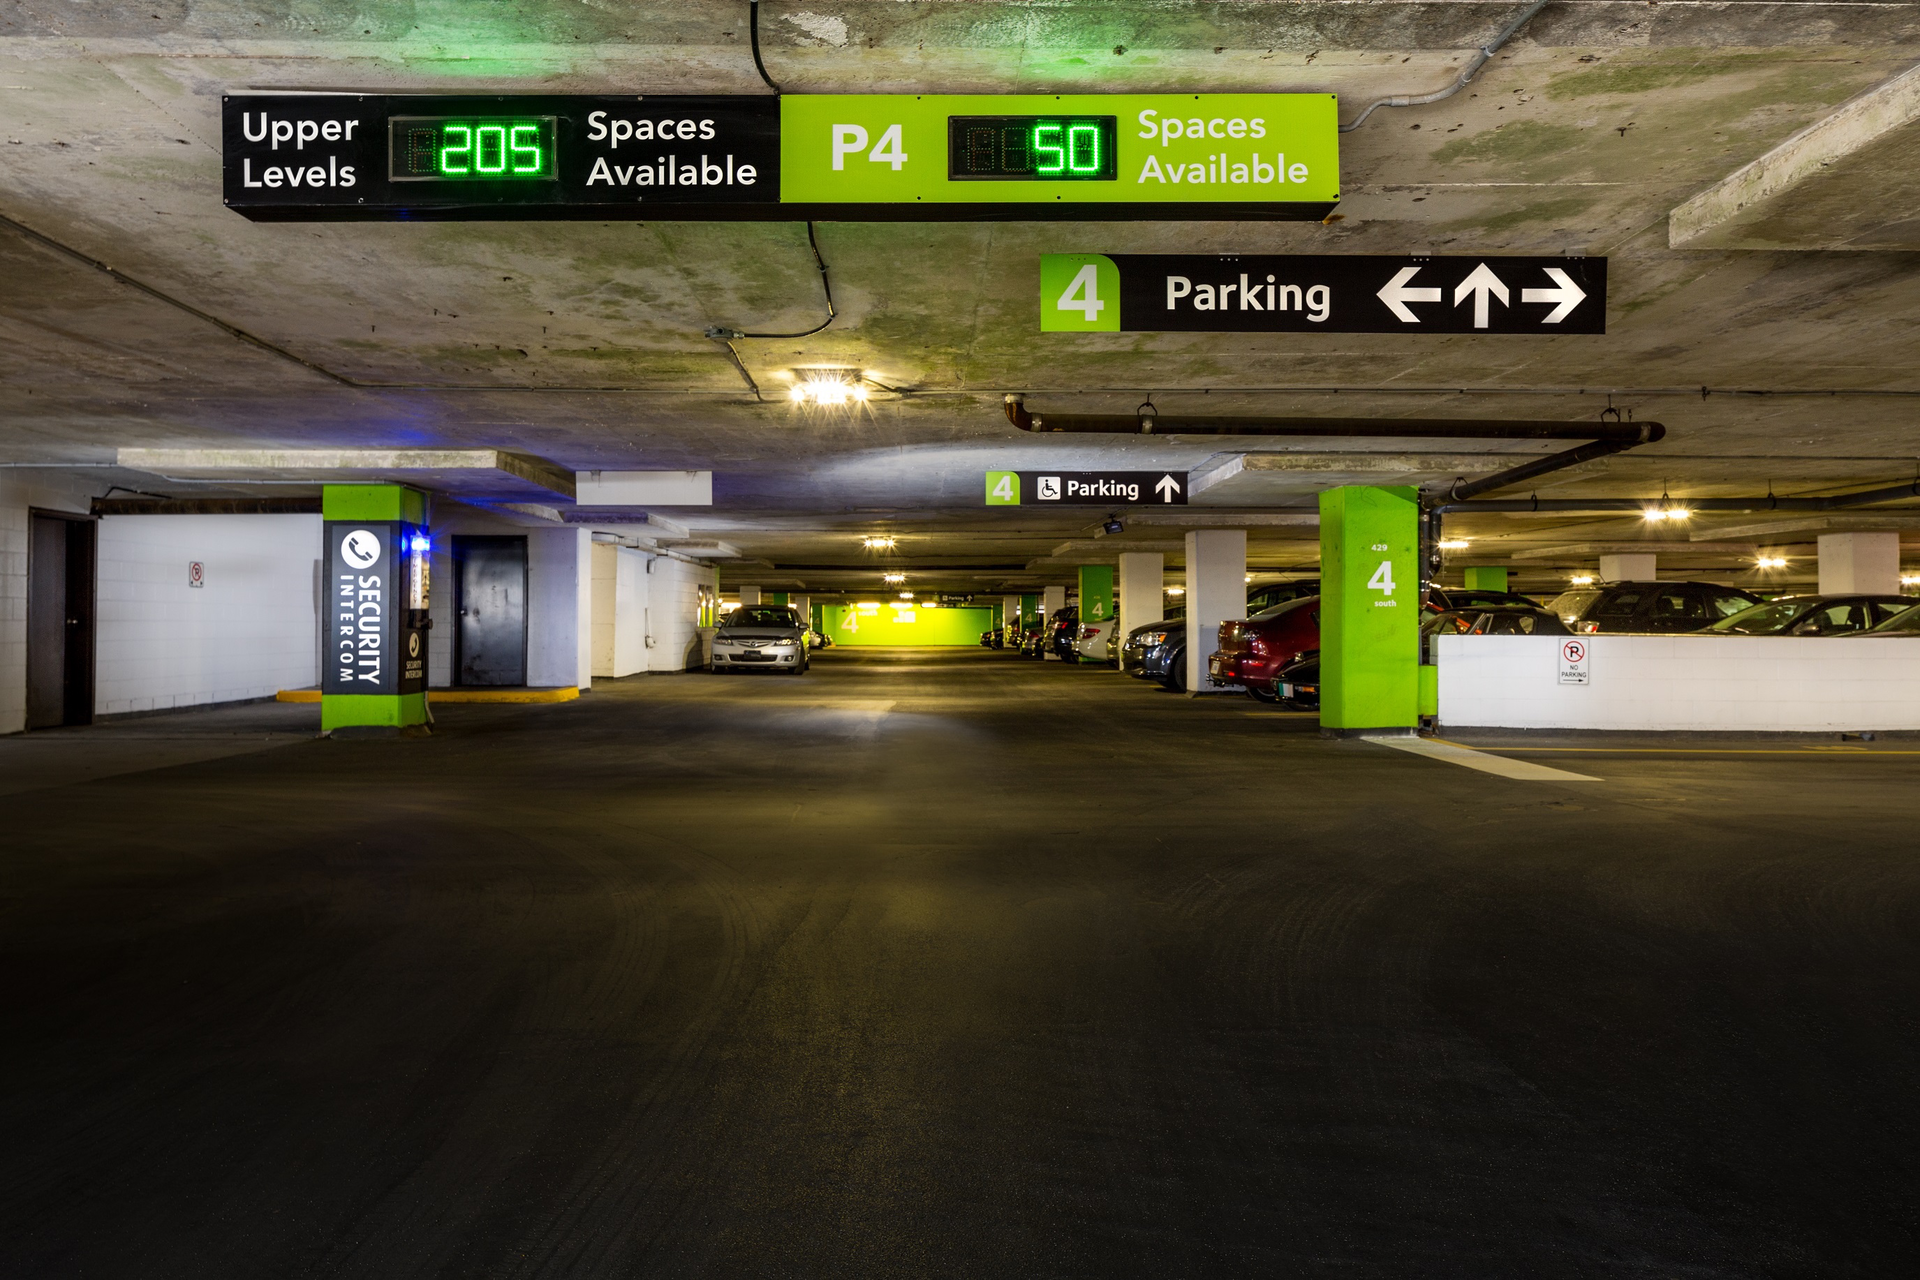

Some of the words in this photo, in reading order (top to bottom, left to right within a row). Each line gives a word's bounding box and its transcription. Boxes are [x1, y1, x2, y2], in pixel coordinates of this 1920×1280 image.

[243, 112, 359, 147] Upper
[587, 111, 716, 148] Spaces
[1137, 109, 1267, 146] Spaces
[440, 124, 542, 175] 205
[831, 124, 908, 171] P4
[1032, 124, 1100, 175] 50
[243, 156, 356, 188] Levels
[586, 154, 757, 186] Available
[1137, 152, 1309, 184] Available
[1057, 265, 1104, 321] 4
[1166, 274, 1330, 322] Parking
[992, 475, 1013, 501] 4
[1067, 479, 1139, 501] Parking
[1371, 544, 1388, 552] 429
[1367, 561, 1396, 595] 4
[1092, 602, 1104, 616] 4
[1374, 600, 1397, 608] south
[340, 575, 354, 682] INTERCOM
[358, 575, 381, 685] SECURITY
[841, 610, 859, 634] 4
